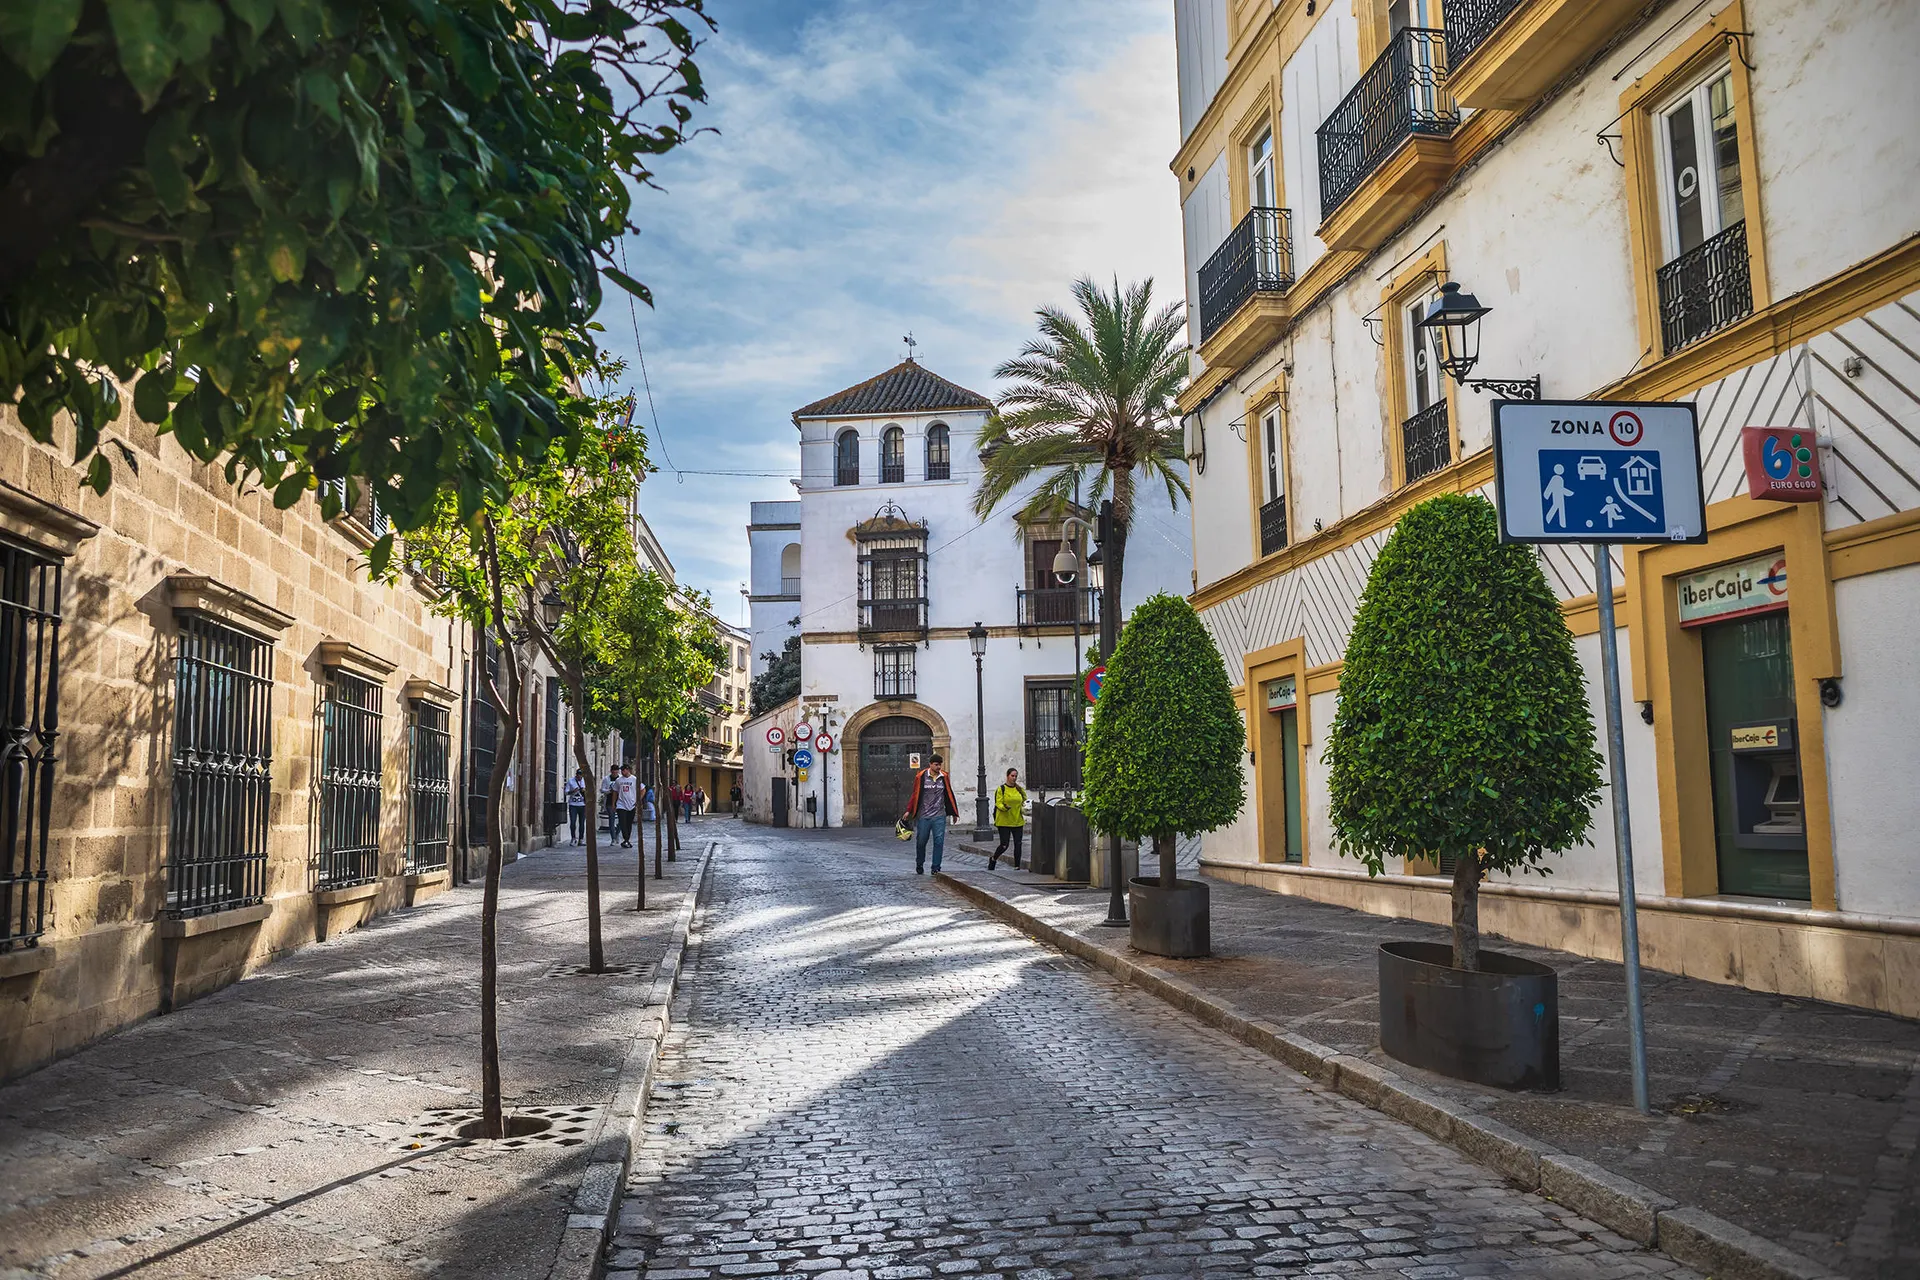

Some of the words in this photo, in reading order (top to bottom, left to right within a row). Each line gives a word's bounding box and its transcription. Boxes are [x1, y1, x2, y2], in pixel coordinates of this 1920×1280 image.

[1550, 420, 1604, 435] ZONA
[1618, 422, 1634, 434] 10
[1770, 481, 1793, 490] EURO
[1794, 480, 1817, 490] 6000
[1683, 572, 1753, 606] iberCaja
[1732, 733, 1760, 744] iberCaja
